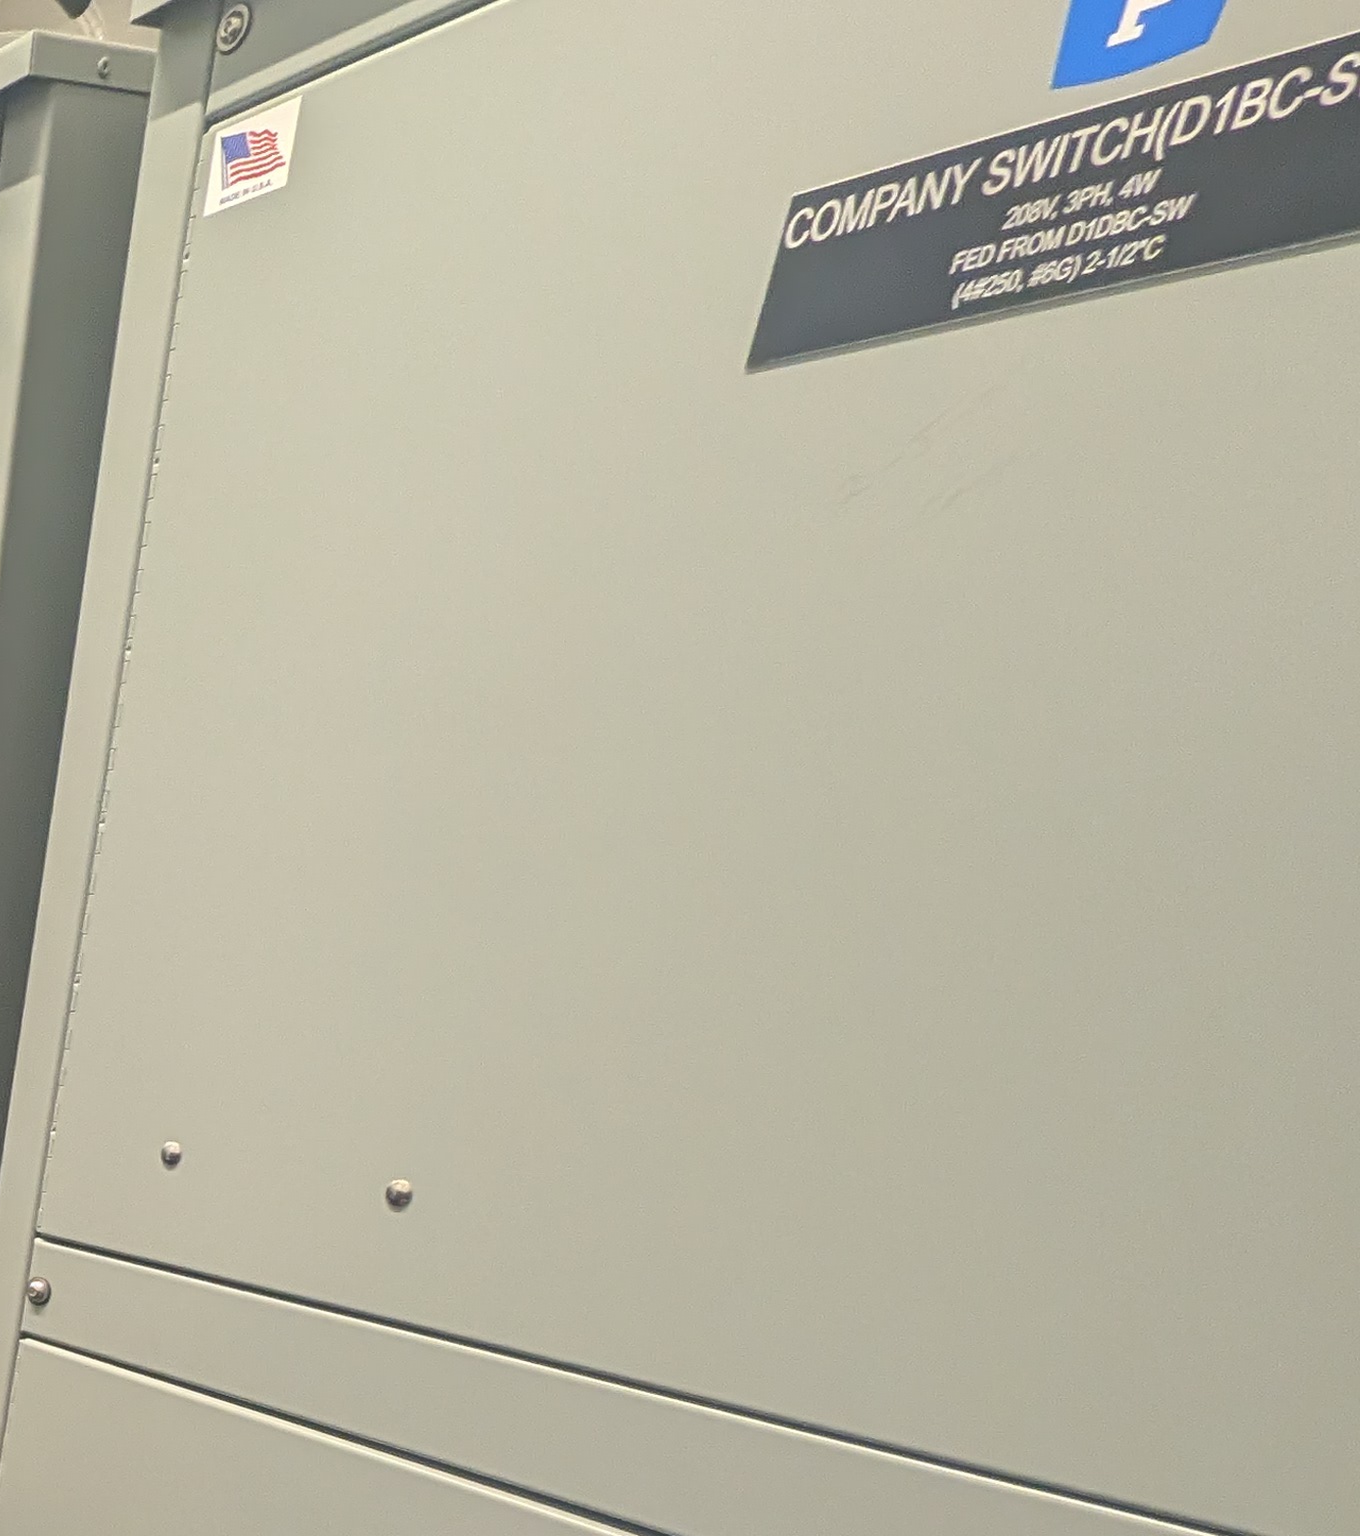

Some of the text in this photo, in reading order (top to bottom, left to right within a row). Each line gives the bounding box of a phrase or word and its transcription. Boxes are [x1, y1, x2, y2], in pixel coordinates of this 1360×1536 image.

[784, 157, 982, 249] COMPANY
[1000, 167, 1164, 231] 208V, 3PH, 4W
[949, 245, 997, 276] FED
[998, 226, 1065, 267] FROM
